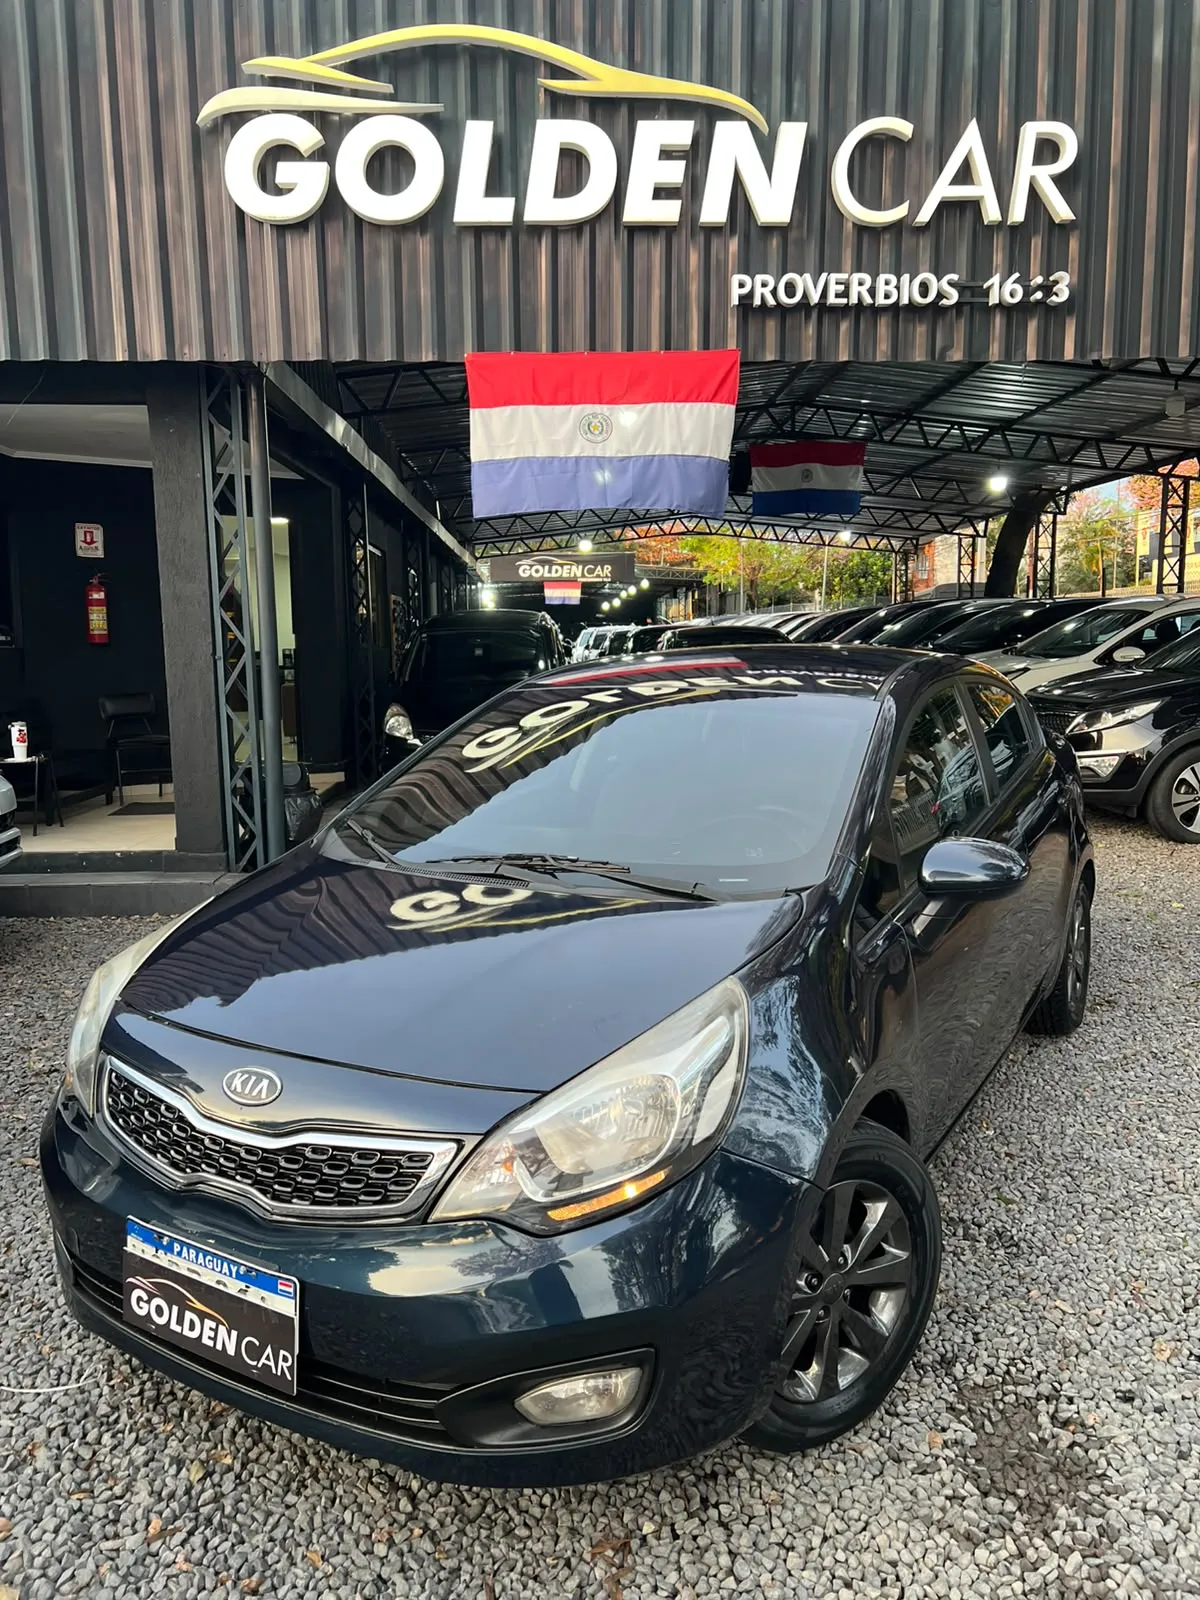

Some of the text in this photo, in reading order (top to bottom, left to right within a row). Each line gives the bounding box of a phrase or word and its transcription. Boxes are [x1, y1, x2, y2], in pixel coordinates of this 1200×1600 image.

[224, 112, 1078, 228] GOLDEN CAR
[731, 271, 1071, 308] PROVERBIOS 16:3
[518, 564, 612, 578] GOLDEN CAR
[230, 1072, 270, 1099] KIA
[173, 1242, 239, 1279] PARAGUAY
[130, 1288, 293, 1381] GOLDEN CAR
